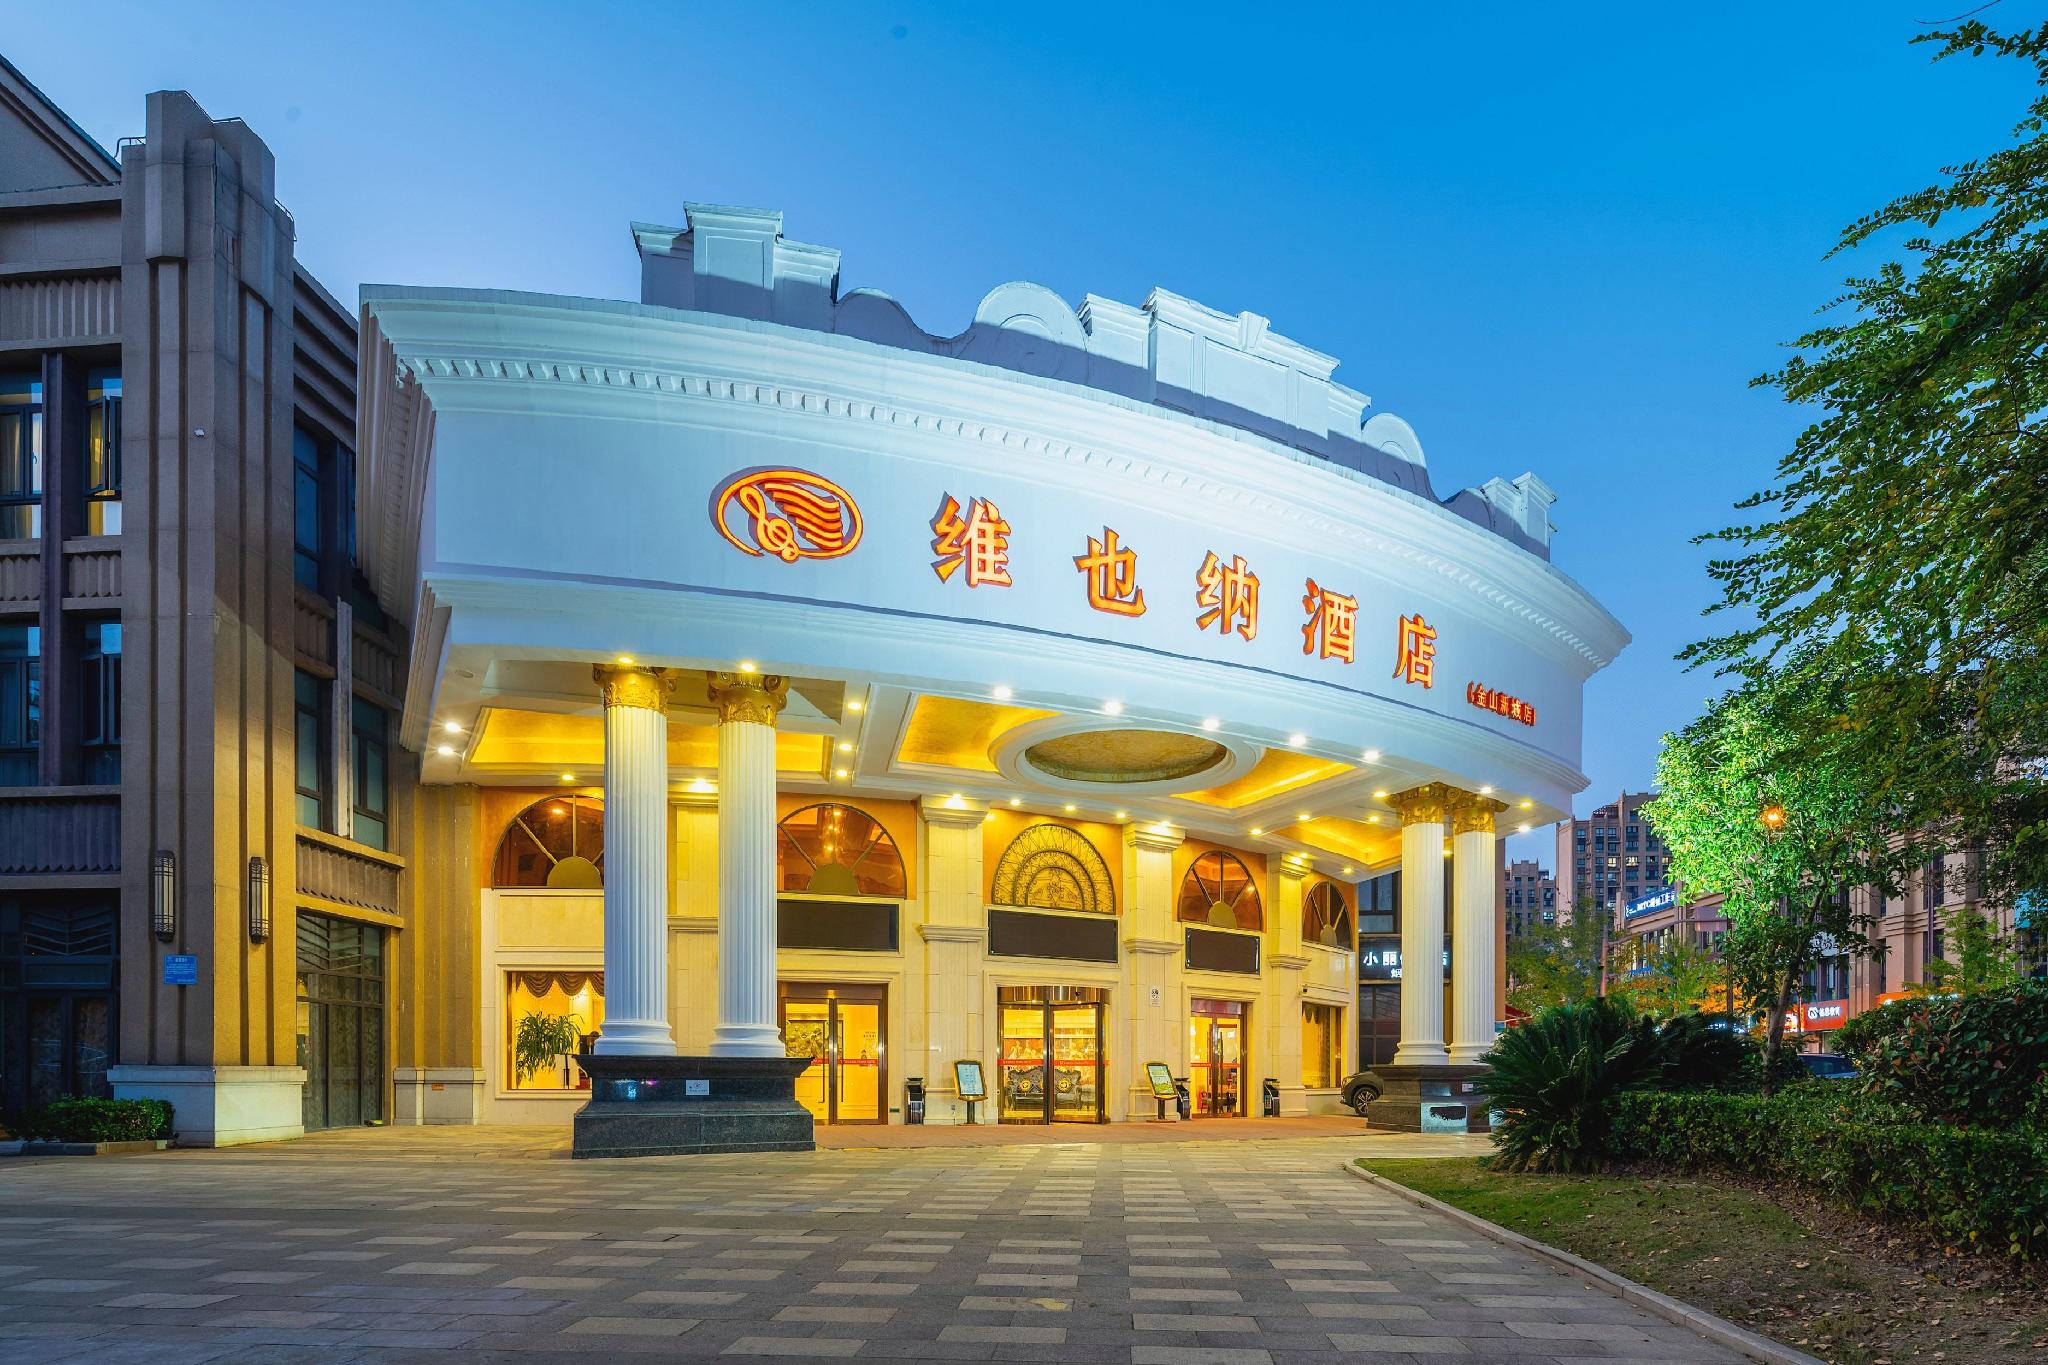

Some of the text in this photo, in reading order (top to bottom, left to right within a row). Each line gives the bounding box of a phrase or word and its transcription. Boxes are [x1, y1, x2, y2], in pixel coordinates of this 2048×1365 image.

[929, 491, 1438, 689] 维也纳酒店
